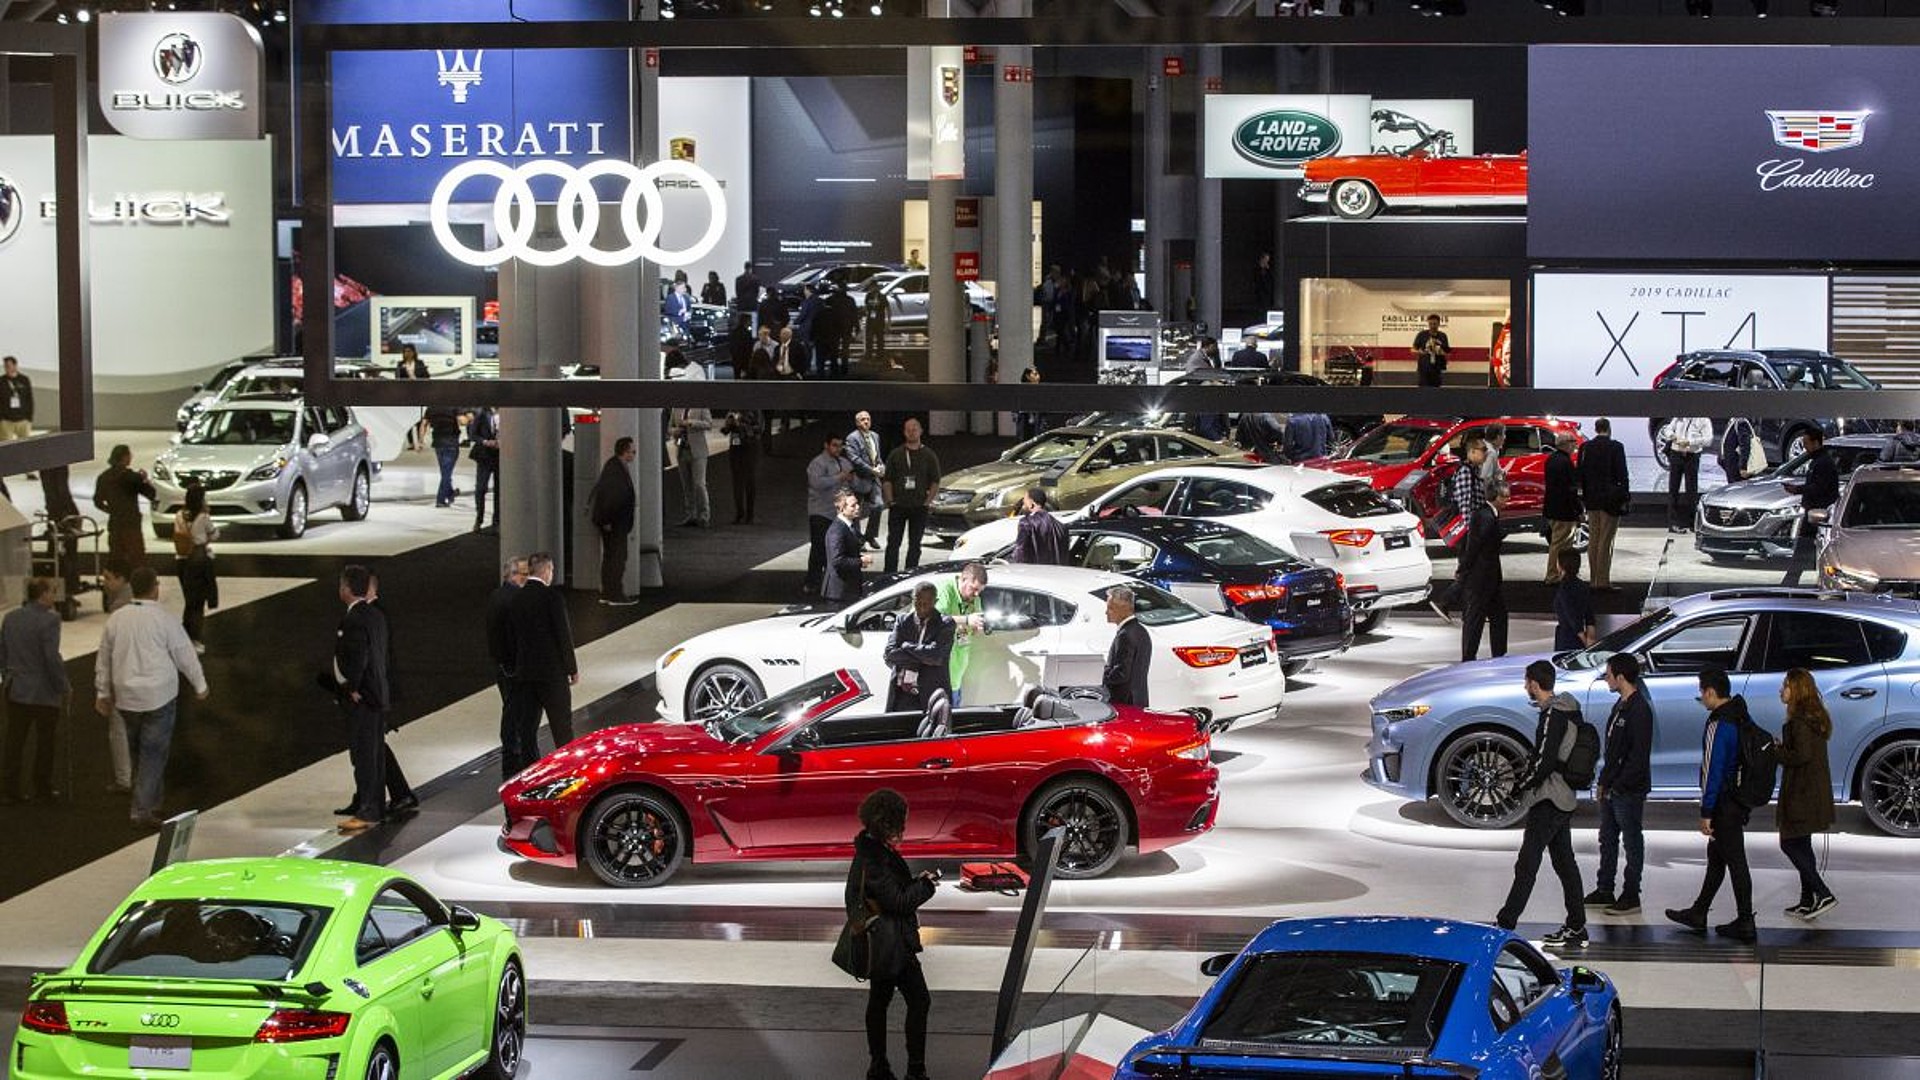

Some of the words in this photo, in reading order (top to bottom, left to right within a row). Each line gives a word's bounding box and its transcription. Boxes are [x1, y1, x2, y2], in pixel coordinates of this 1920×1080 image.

[112, 92, 246, 110] BUICK
[1256, 121, 1306, 135] LAND
[331, 122, 604, 157] MASERATI
[1260, 136, 1320, 151] ROVER
[1756, 158, 1874, 191] Cadillac
[1630, 287, 1662, 297] 2019
[1666, 287, 1732, 298] CADILLAC
